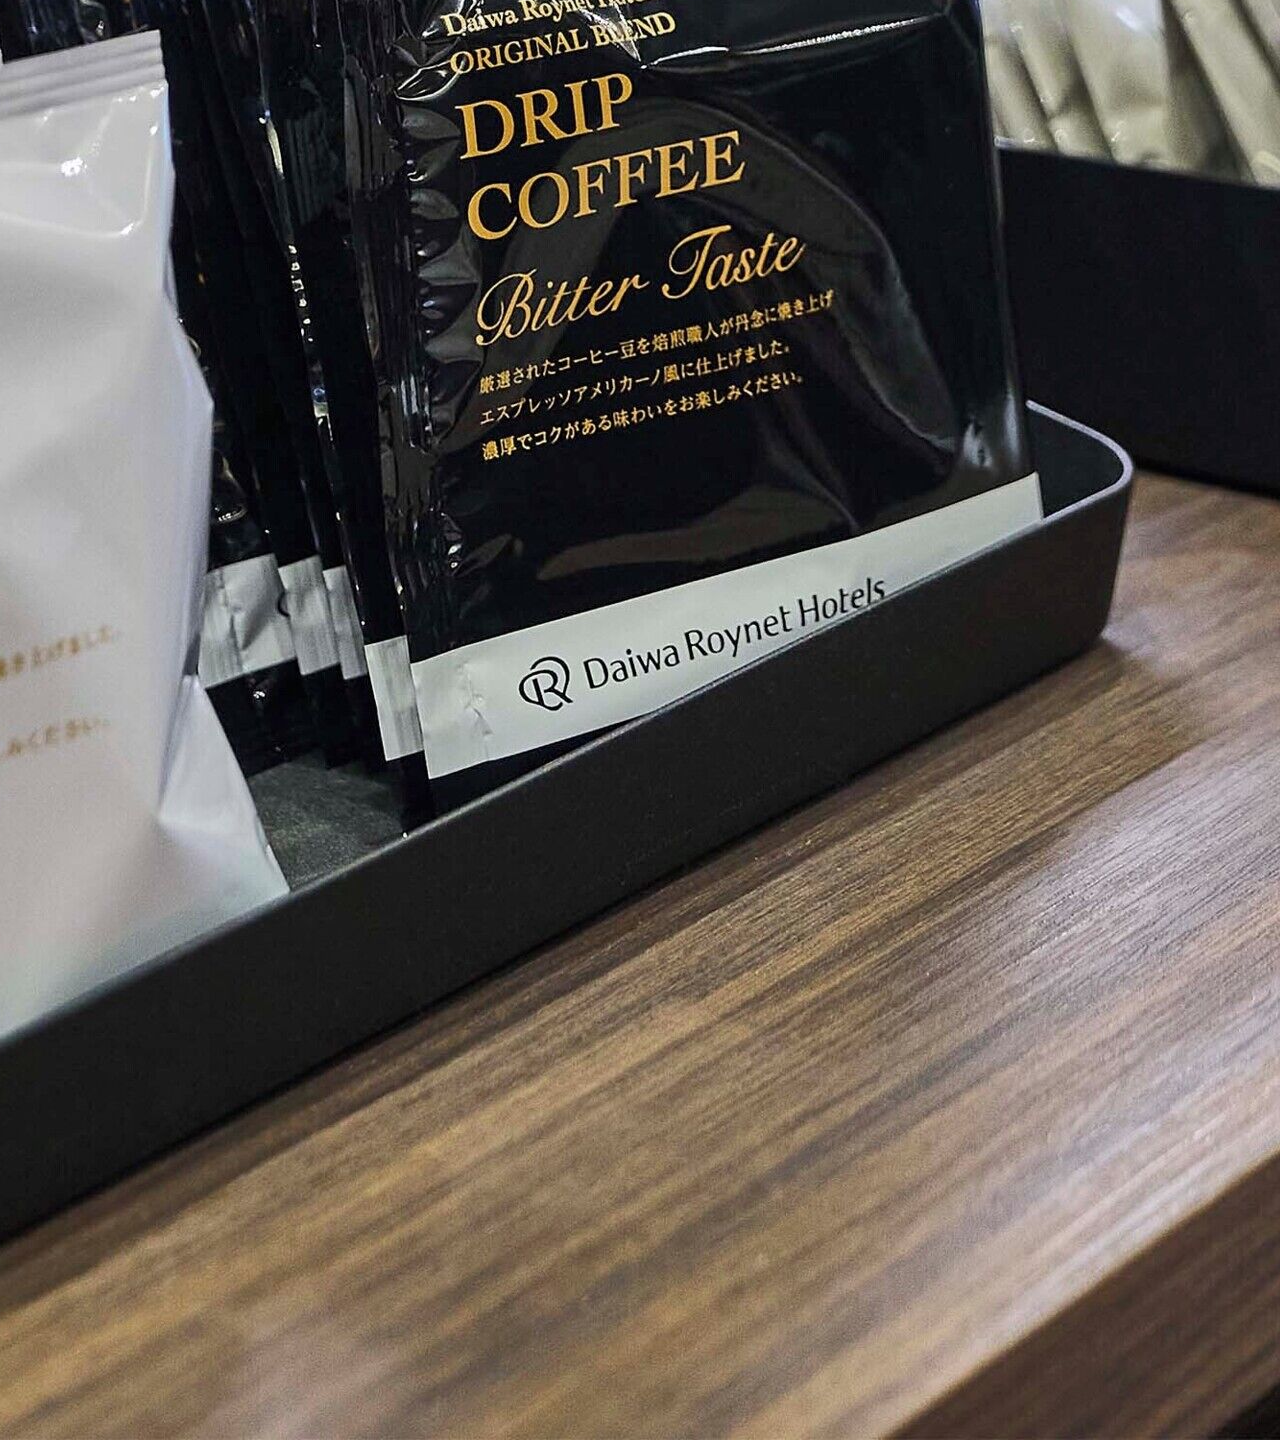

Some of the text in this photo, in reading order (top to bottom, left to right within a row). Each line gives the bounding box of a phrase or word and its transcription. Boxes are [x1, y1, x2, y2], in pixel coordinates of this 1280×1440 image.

[440, 7, 519, 36] Daiwa
[450, 10, 676, 75] ORIGINAL BLEND
[455, 73, 633, 160] DRIP
[467, 130, 745, 240] COFFEE
[475, 225, 806, 346] Bitter Taste
[480, 339, 790, 426] エスプレッソアメリカーノ風に仕上げました。
[482, 371, 803, 462] 濃厚でコクがある味わいをお楽しみください。
[583, 643, 681, 690] Daiwa
[683, 605, 792, 657] Roynet
[797, 577, 886, 627] Hotels
